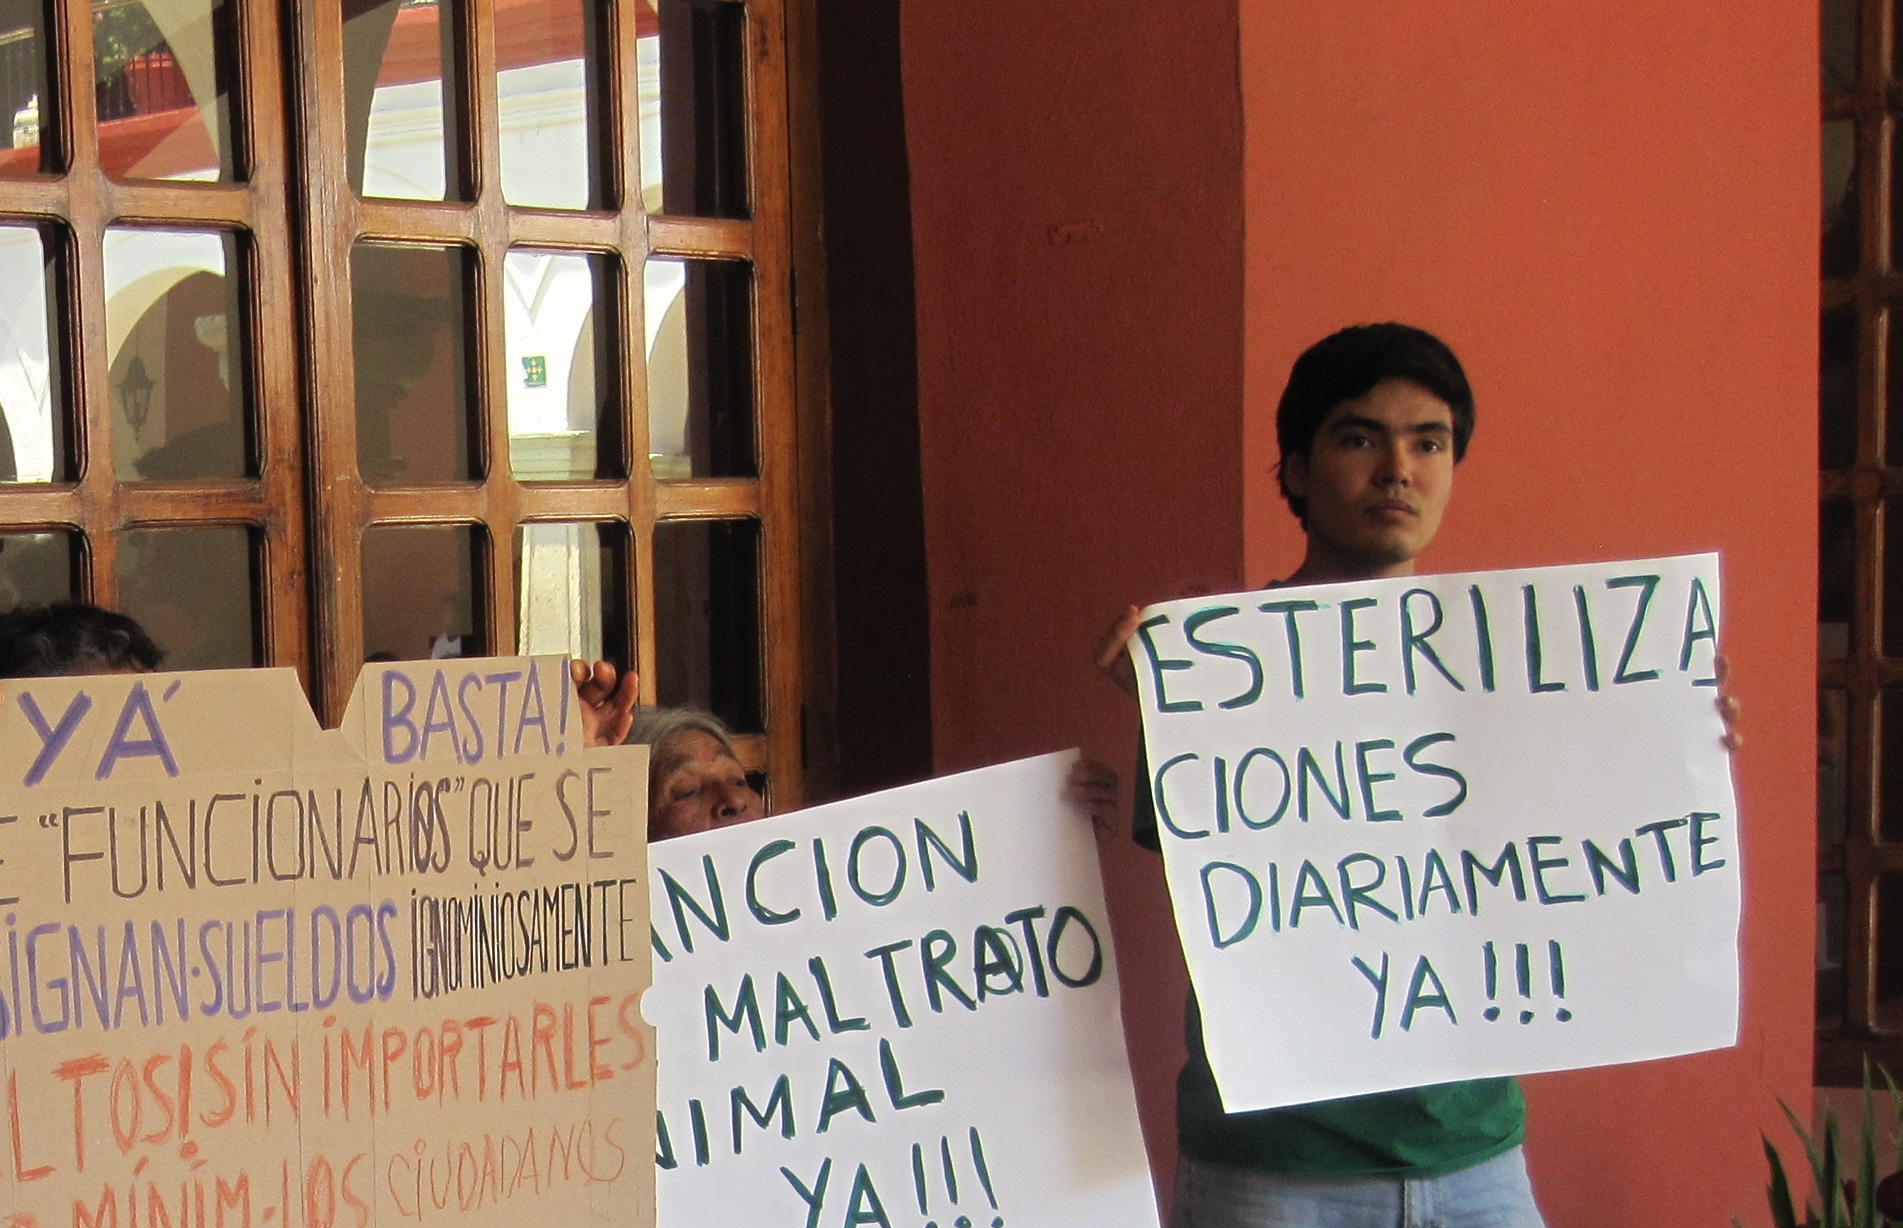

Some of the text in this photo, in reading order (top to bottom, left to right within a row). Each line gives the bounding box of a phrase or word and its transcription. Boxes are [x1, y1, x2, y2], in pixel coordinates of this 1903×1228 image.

[381, 655, 570, 765] BASTA!
[468, 773, 535, 877] QUE
[552, 766, 614, 862] SE
[1154, 732, 1468, 840] CIONES
[650, 809, 979, 963] NCION
[1199, 812, 1727, 949] DIARIAMENTE
[703, 905, 1103, 1062] MALTRATO
[319, 992, 646, 1122] IMPORTARLES
